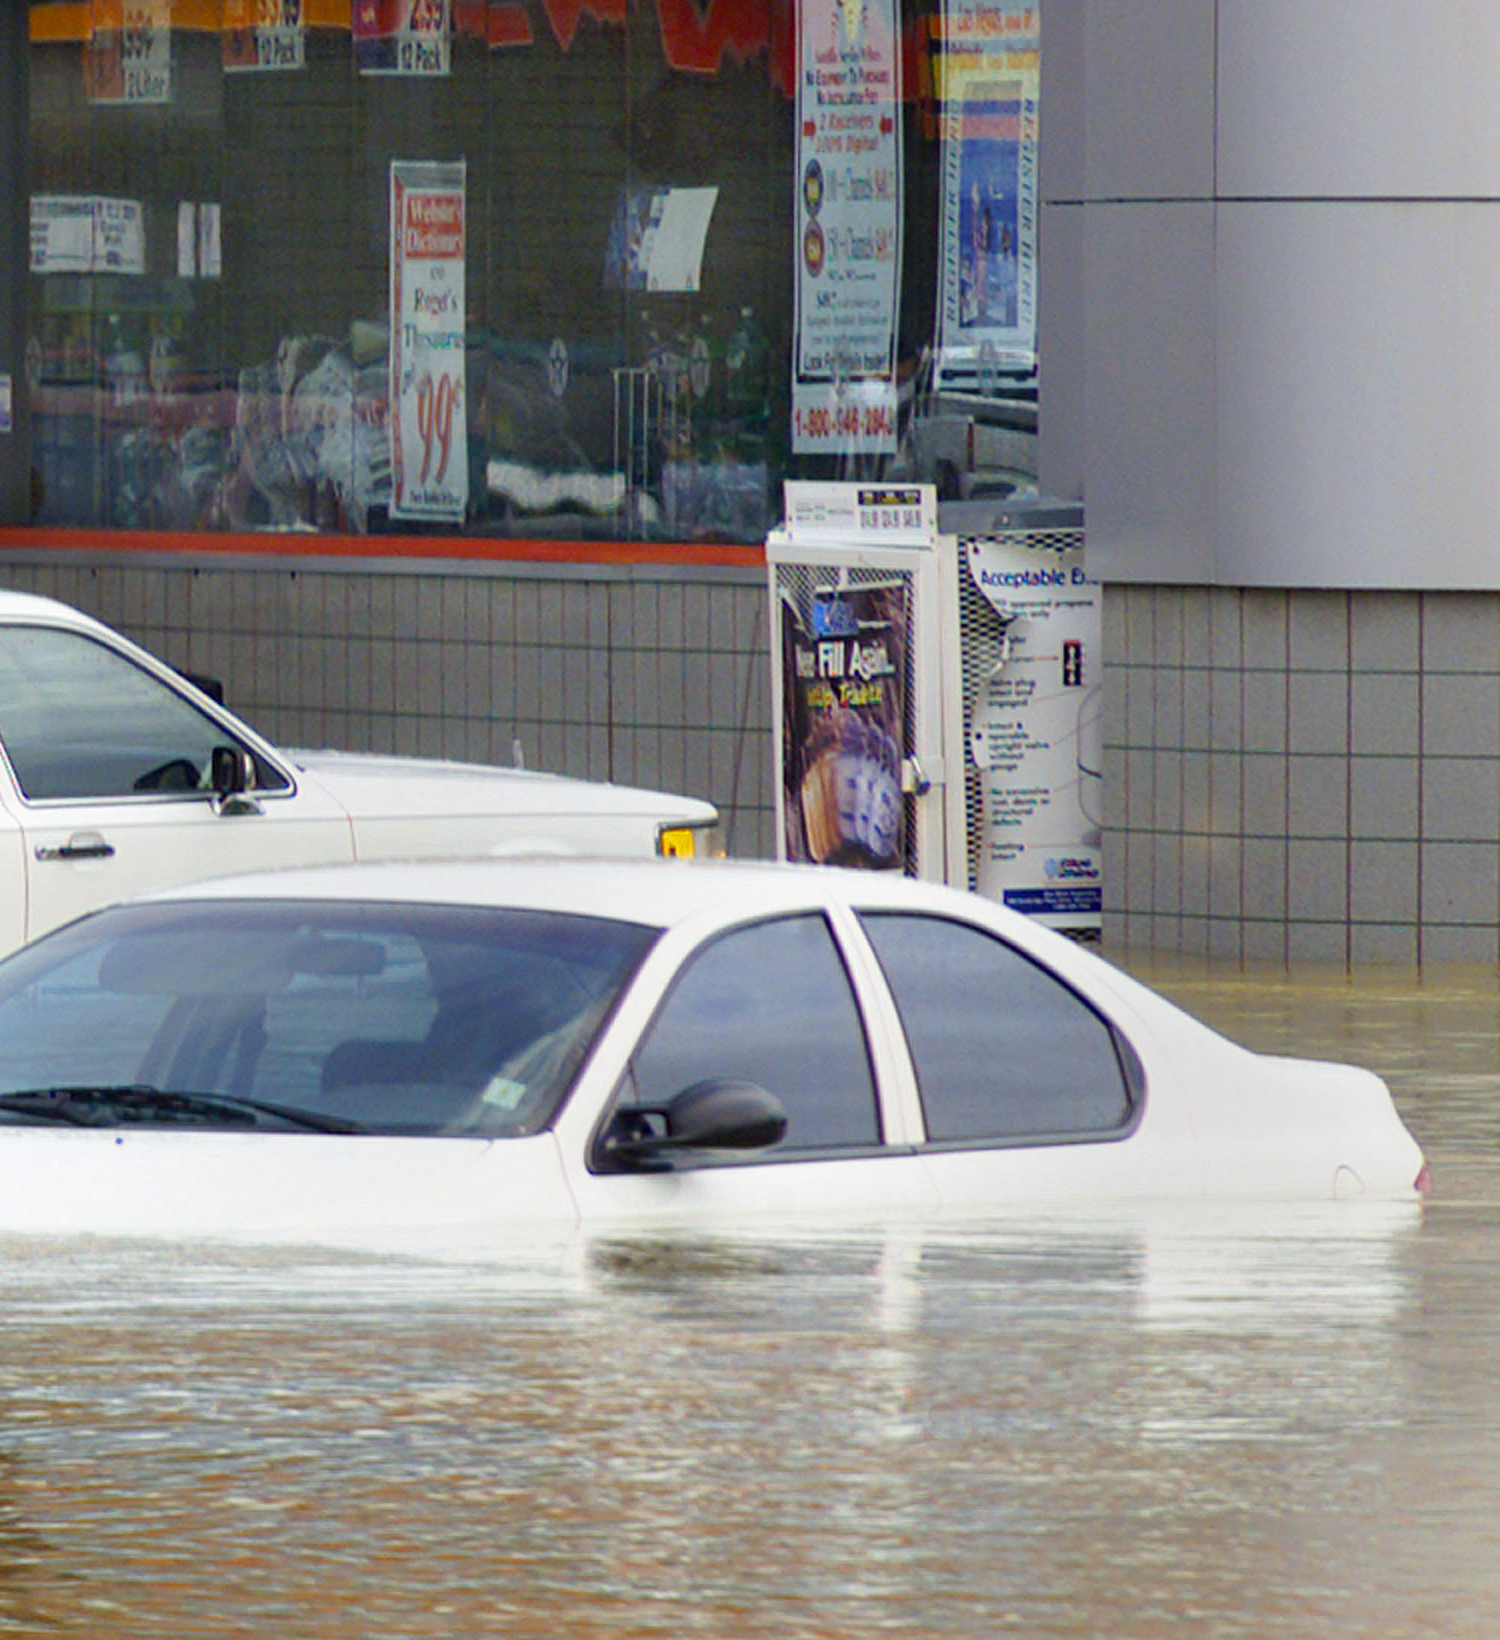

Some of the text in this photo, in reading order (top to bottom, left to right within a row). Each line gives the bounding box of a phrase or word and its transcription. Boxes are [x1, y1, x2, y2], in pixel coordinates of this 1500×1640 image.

[1022, 98, 1035, 232] REGISTER
[946, 192, 957, 322] REGISTER
[982, 566, 1065, 590] Acceptable
[819, 641, 845, 678] Fill
